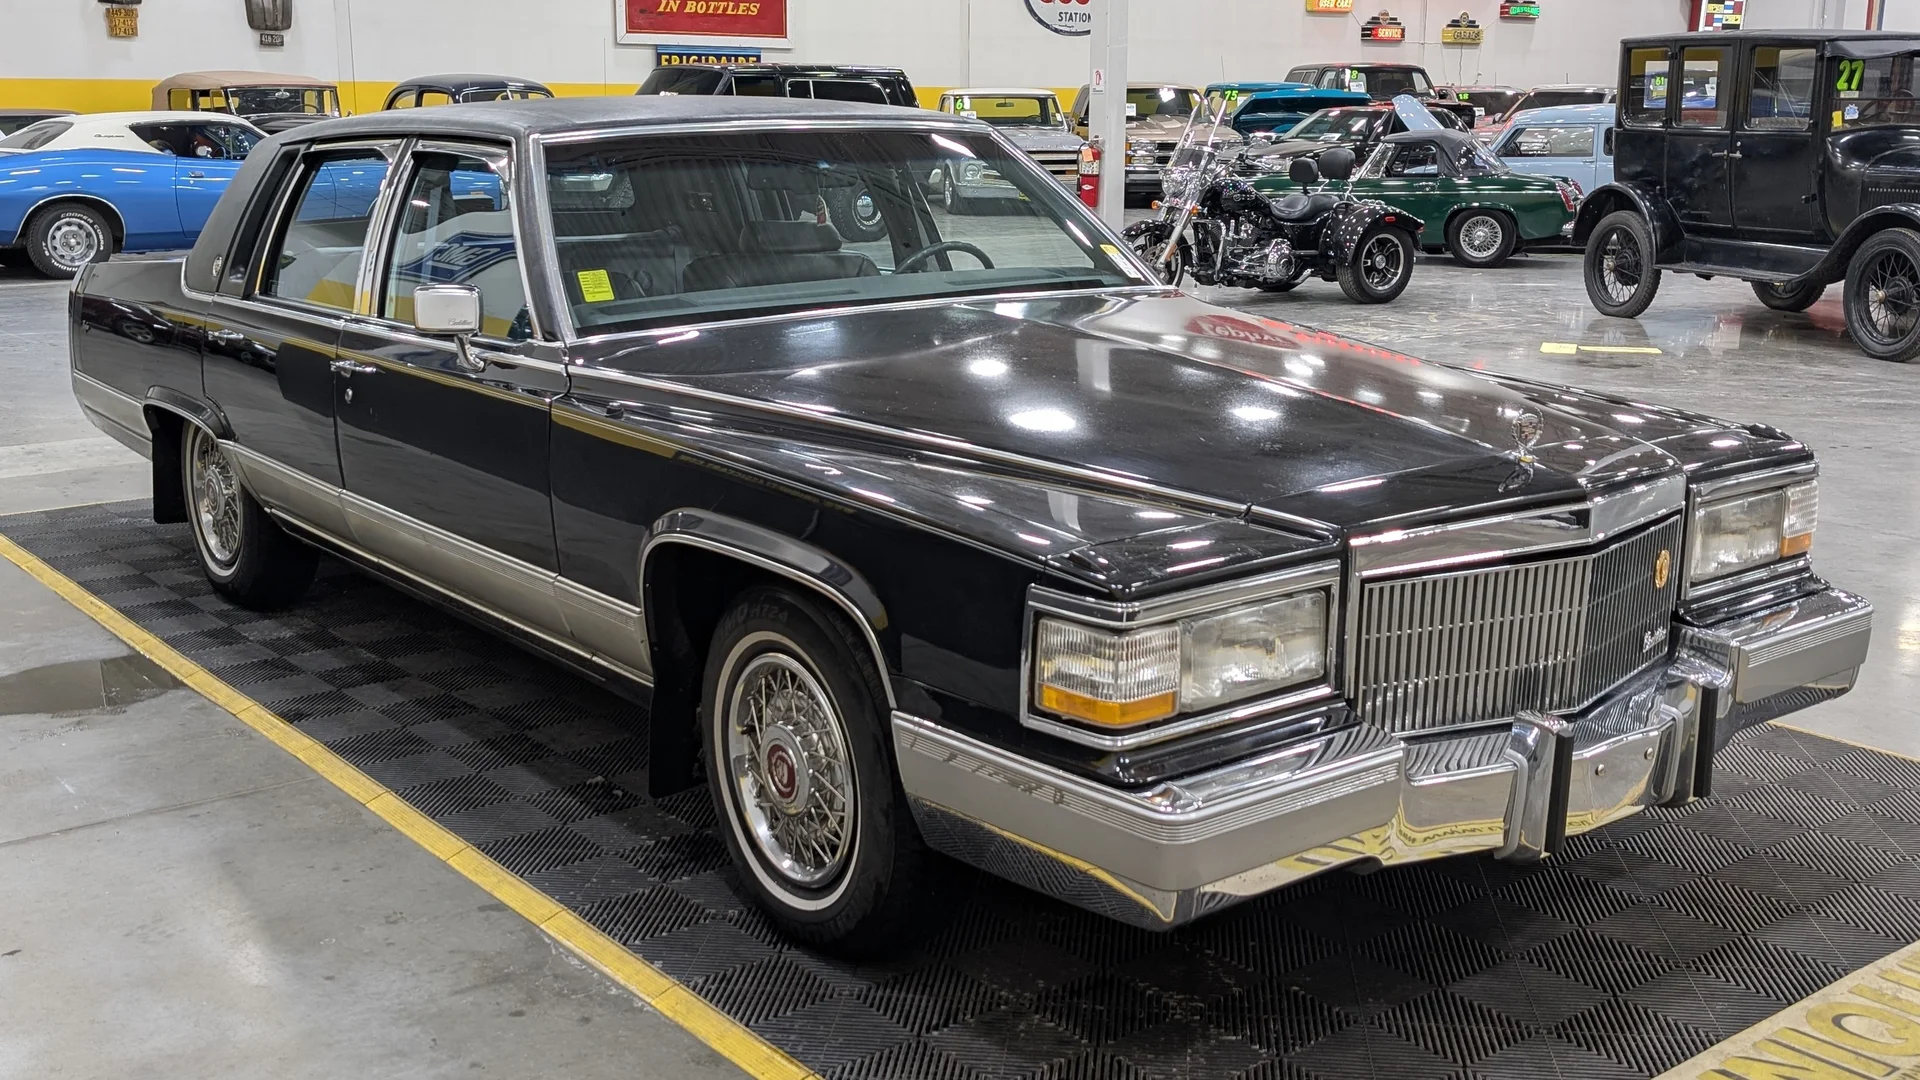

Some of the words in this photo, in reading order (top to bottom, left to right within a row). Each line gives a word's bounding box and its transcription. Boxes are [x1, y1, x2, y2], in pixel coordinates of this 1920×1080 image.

[657, 0, 681, 12] IN
[684, 0, 760, 15] BOTTLES
[1378, 28, 1402, 38] SERVICE
[1837, 60, 1864, 90] 27
[1655, 76, 1665, 86] 61
[1224, 90, 1239, 101] 75
